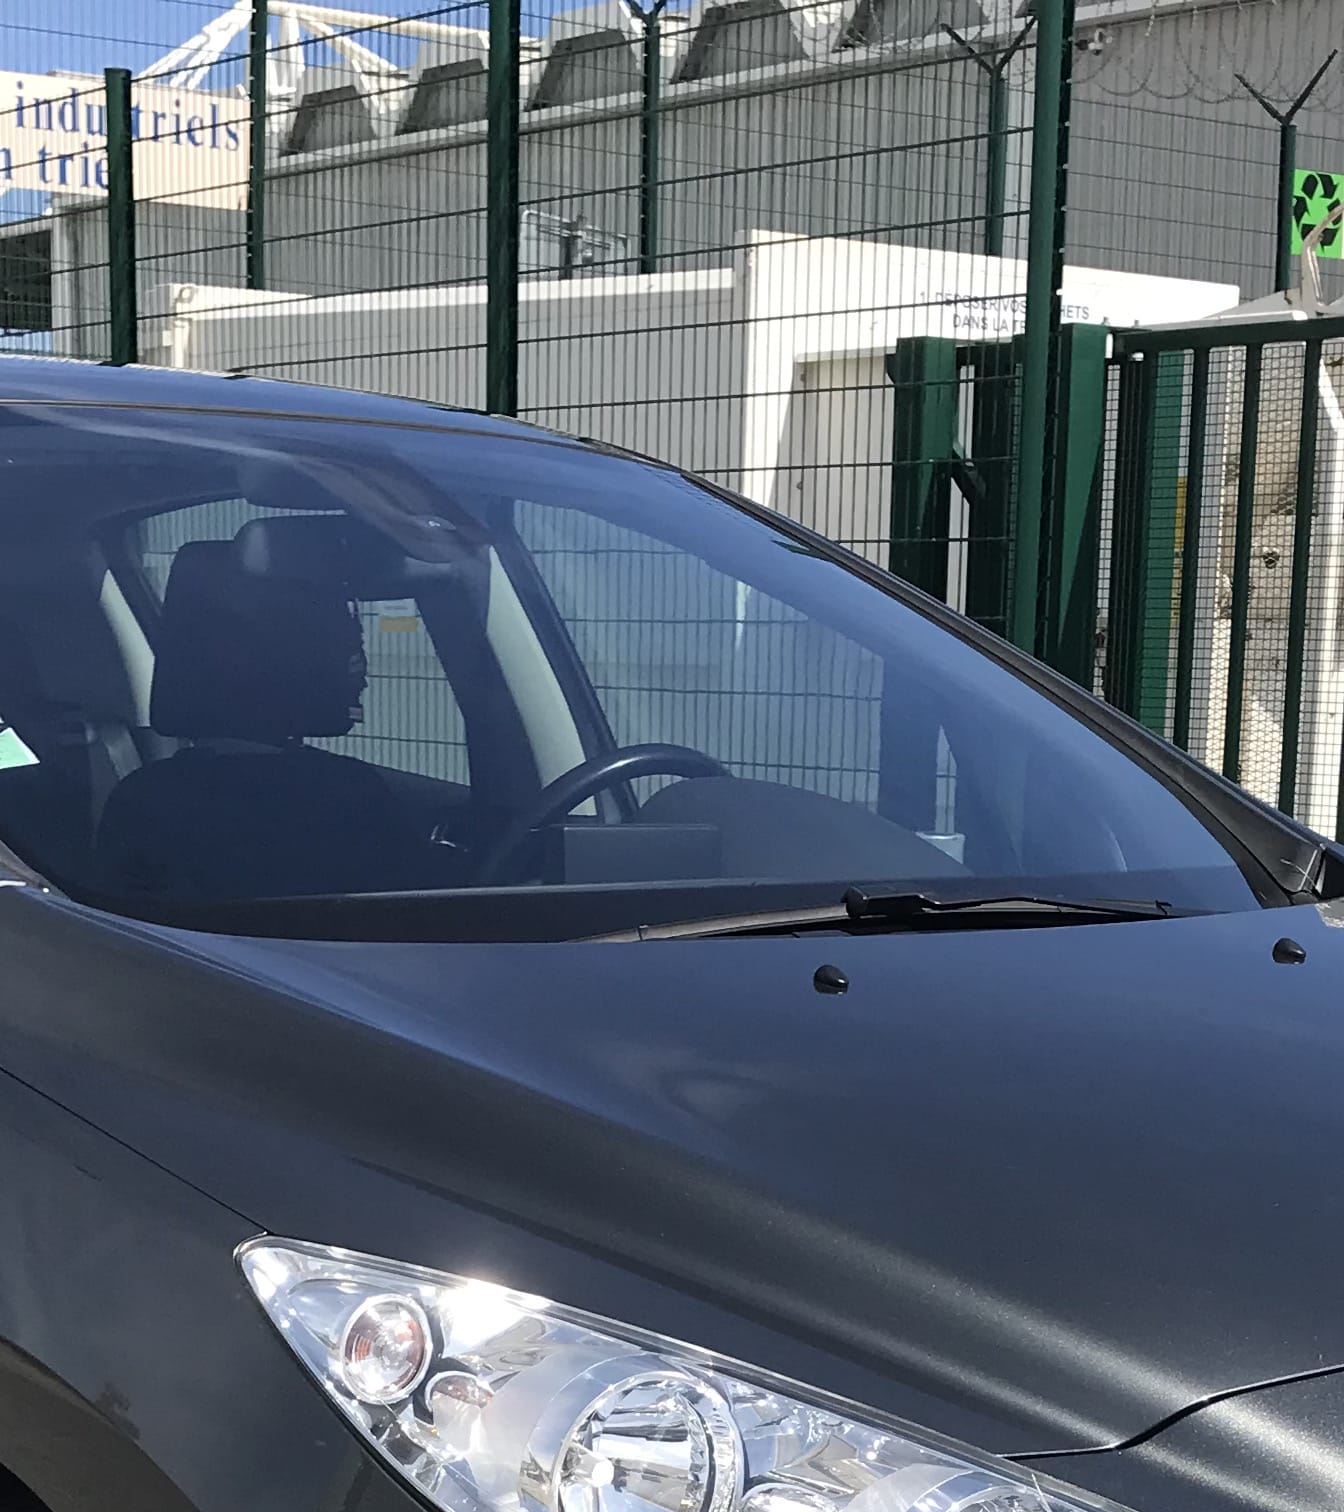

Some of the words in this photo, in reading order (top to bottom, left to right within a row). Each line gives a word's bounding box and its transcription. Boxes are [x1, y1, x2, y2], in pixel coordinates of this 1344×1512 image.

[15, 80, 240, 151] indutriels
[953, 314, 988, 331] DANS
[993, 318, 1009, 333] LA
